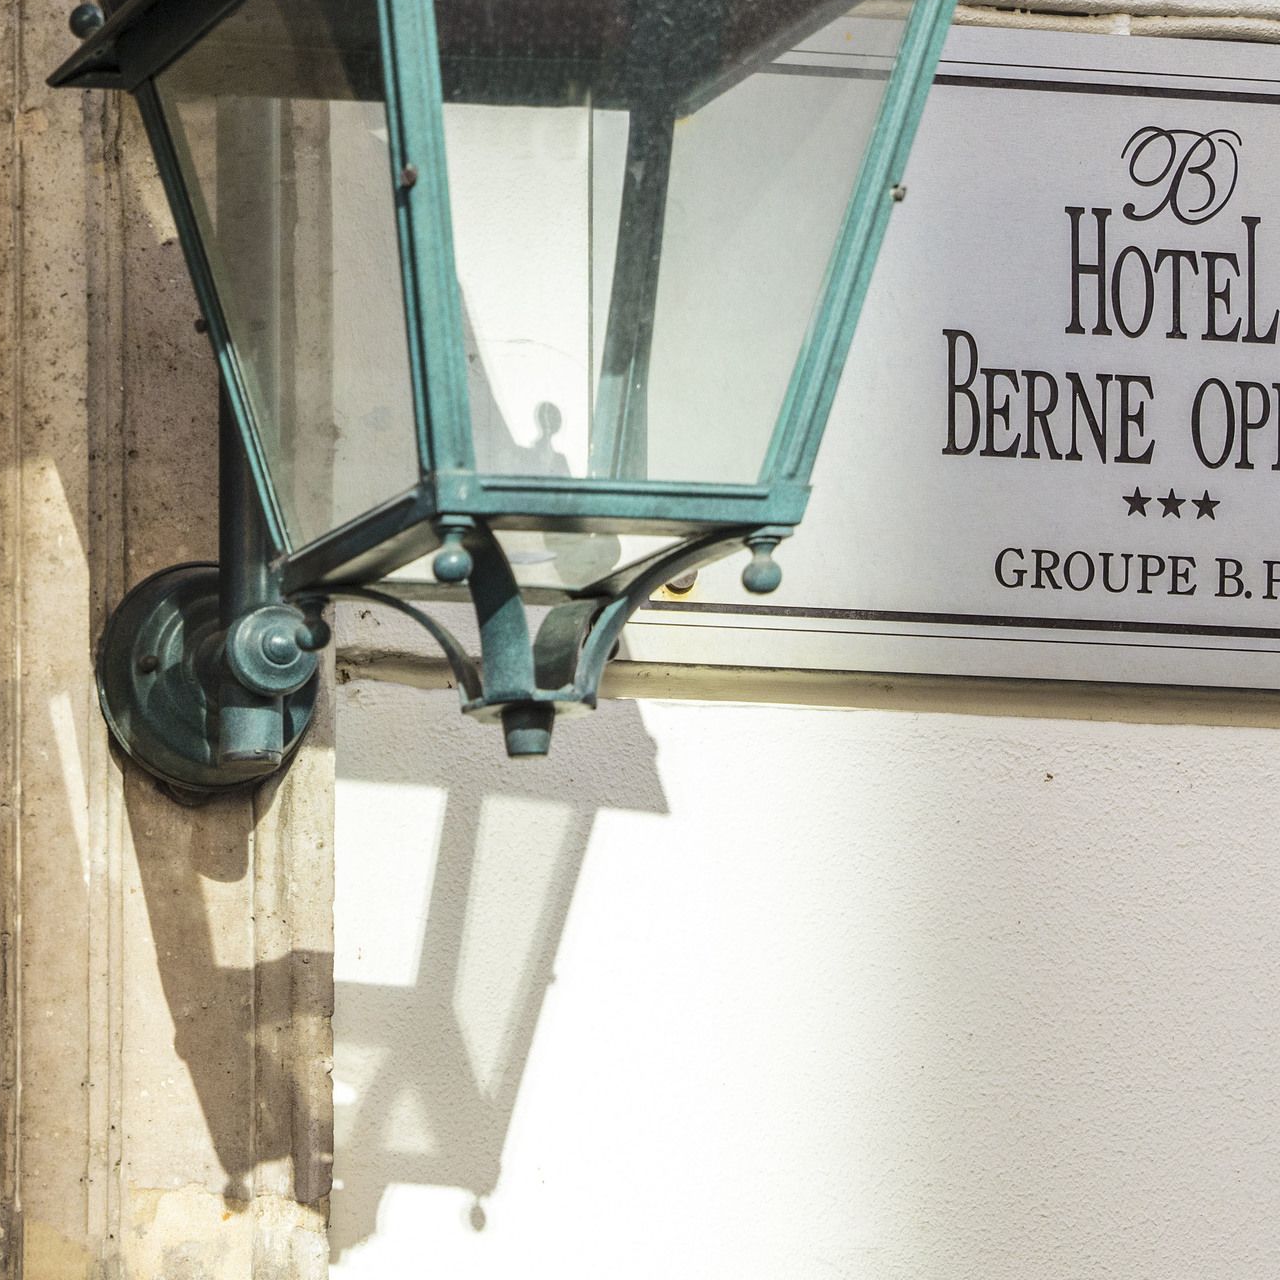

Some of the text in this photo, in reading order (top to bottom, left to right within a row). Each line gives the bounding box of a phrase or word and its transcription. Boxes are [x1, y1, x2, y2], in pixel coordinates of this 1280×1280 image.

[1064, 205, 1280, 345] HOTEL
[941, 328, 1156, 465] BERNE
[994, 547, 1198, 596] GROUPE
